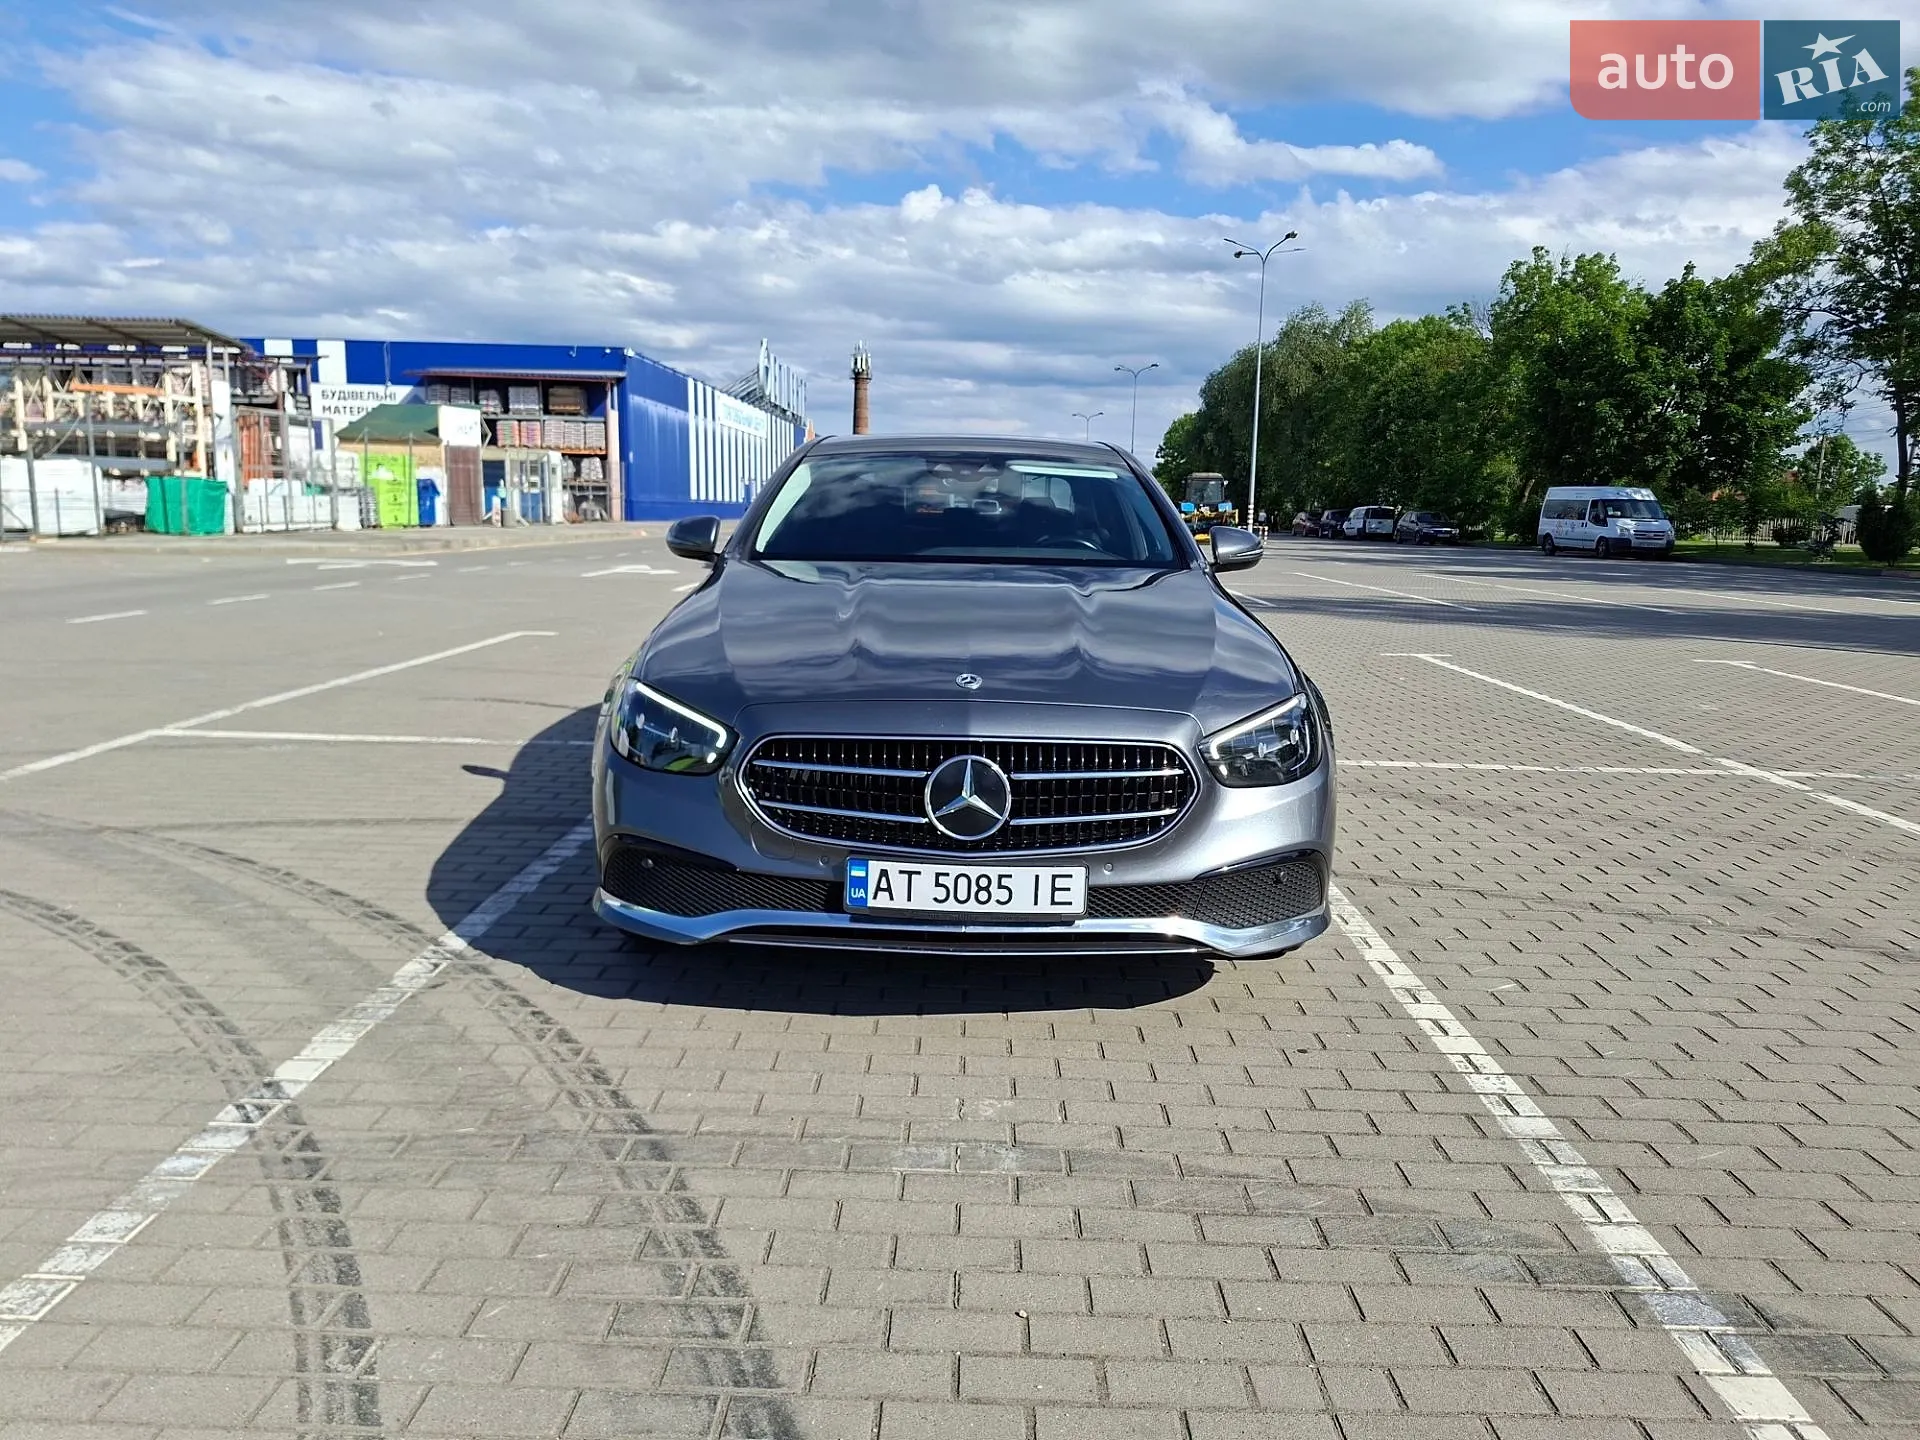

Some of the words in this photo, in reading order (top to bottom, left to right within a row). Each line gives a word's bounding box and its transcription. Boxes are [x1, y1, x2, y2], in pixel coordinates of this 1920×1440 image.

[321, 389, 397, 402] БУДІВЕЛЬНІ
[322, 405, 369, 416] МАТЕРІ
[872, 868, 922, 902] AT
[932, 872, 1013, 906] 5085
[1033, 873, 1073, 906] IE
[851, 888, 866, 899] UA
